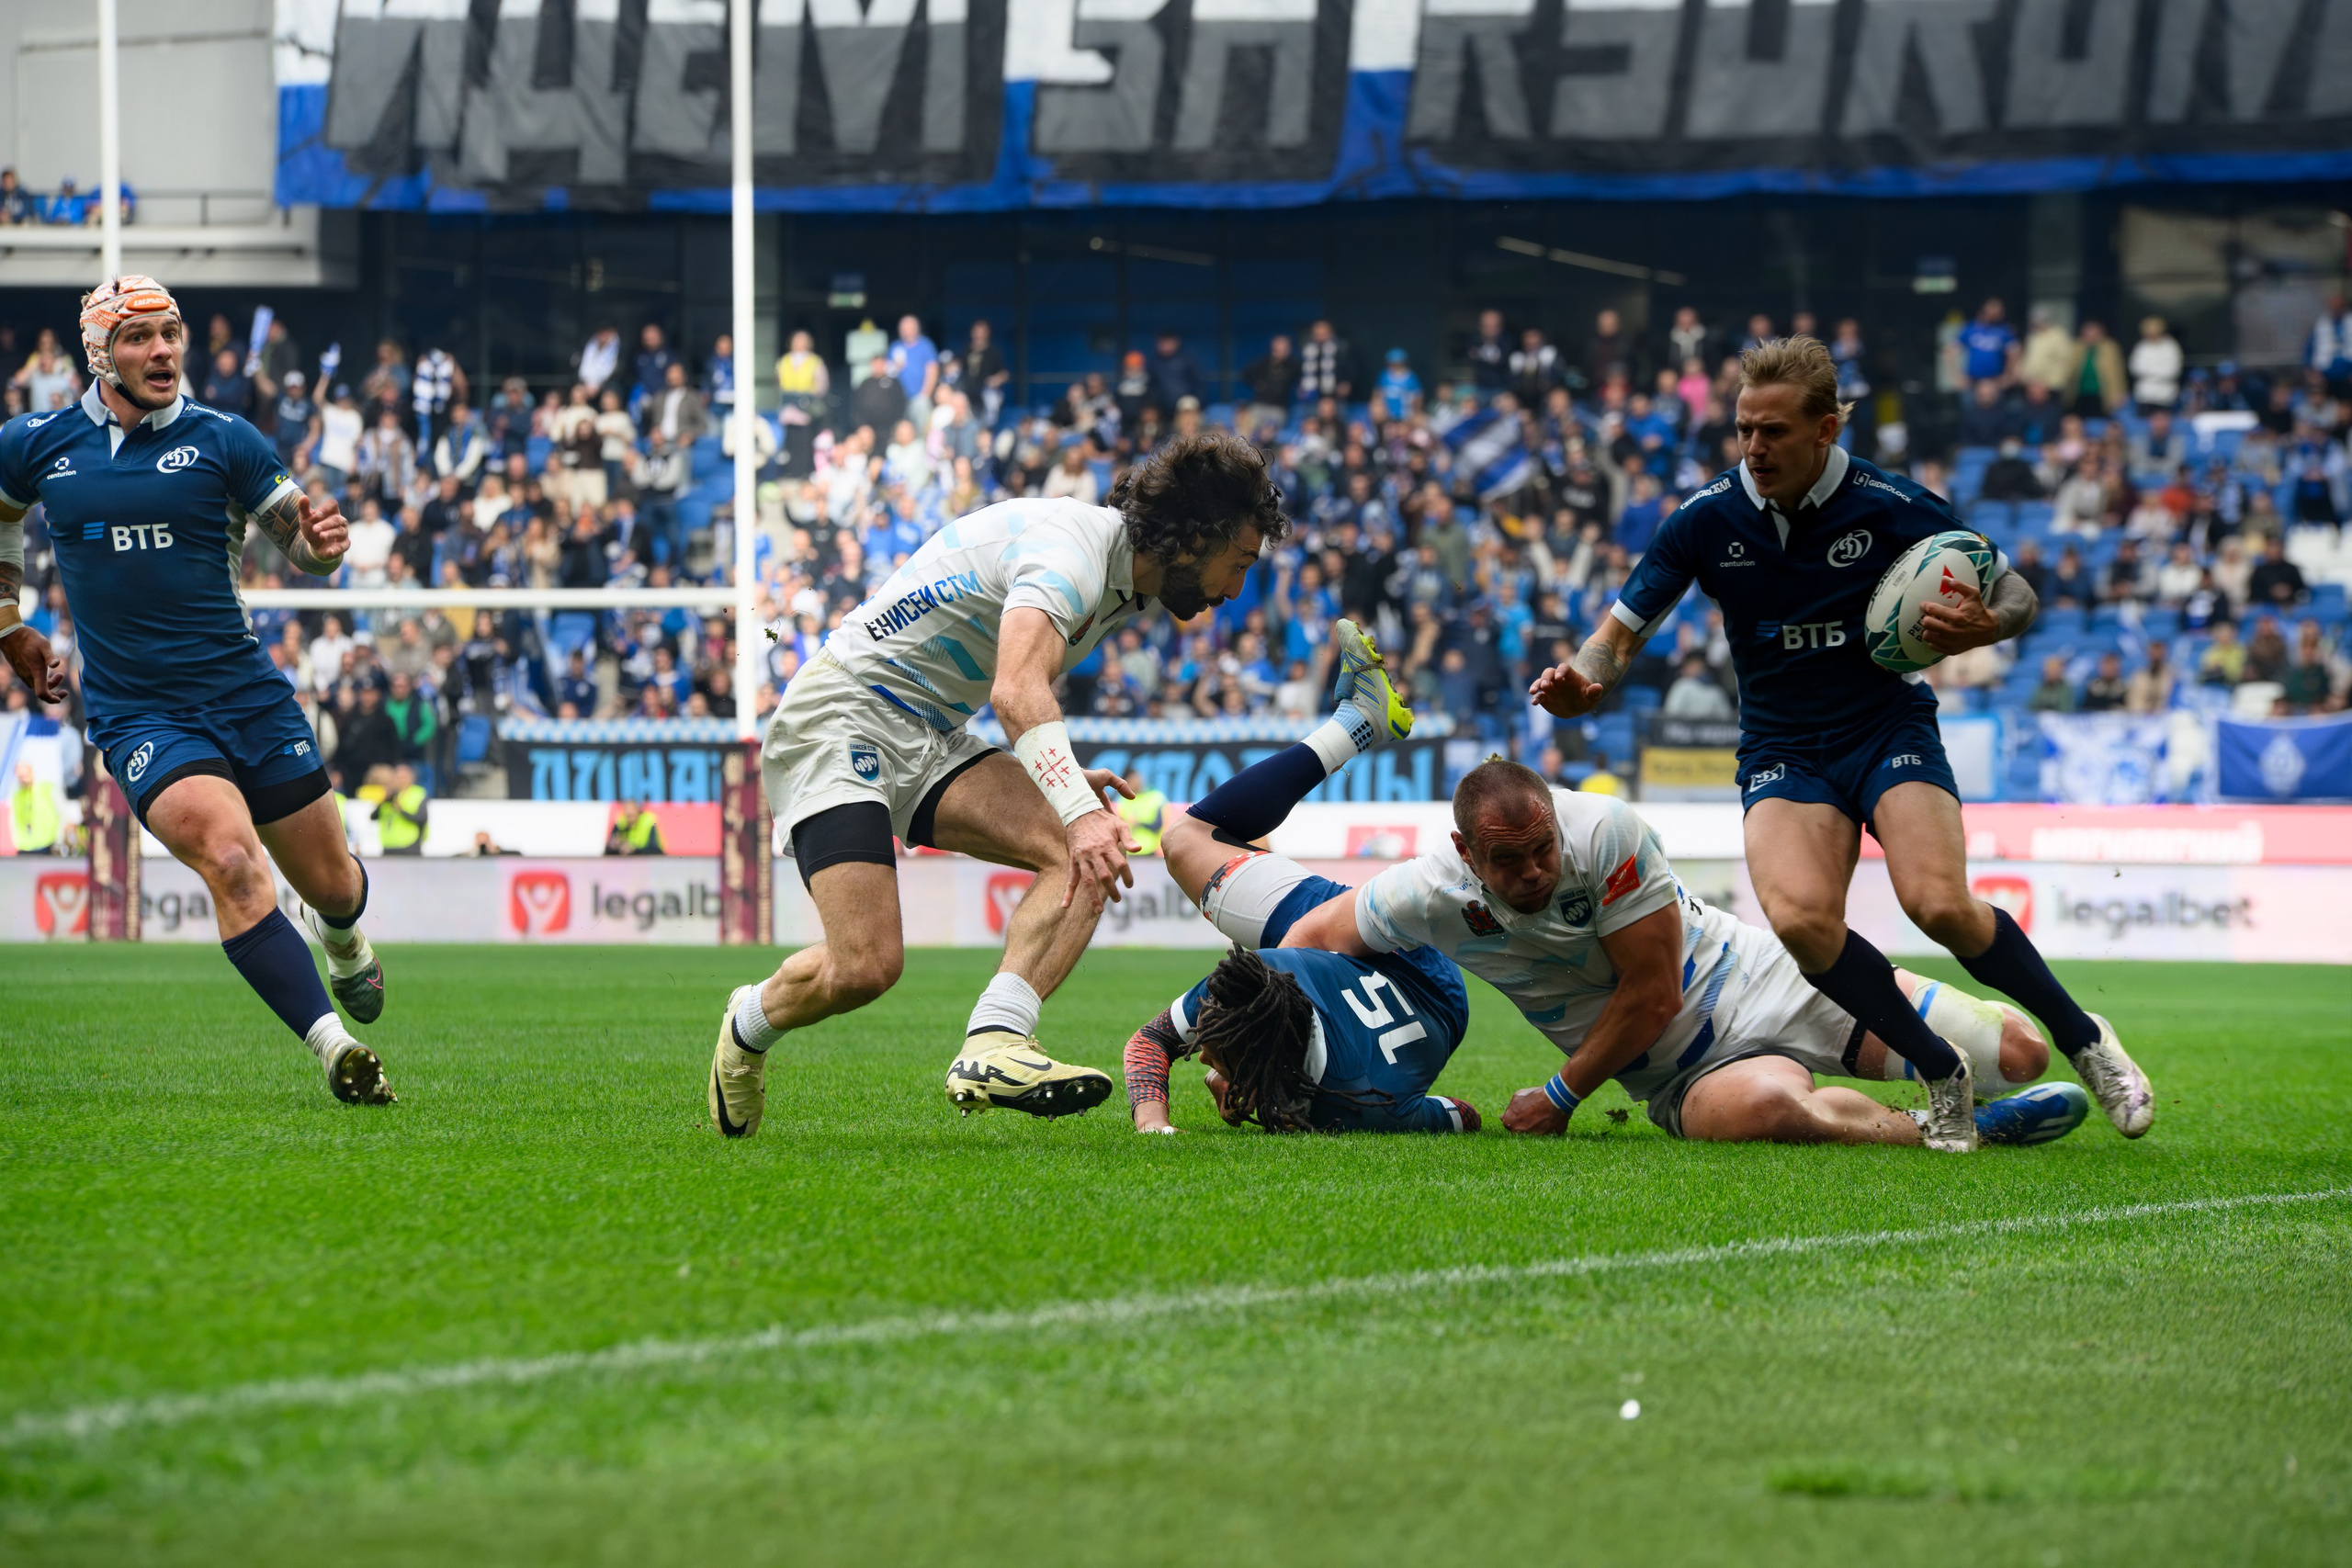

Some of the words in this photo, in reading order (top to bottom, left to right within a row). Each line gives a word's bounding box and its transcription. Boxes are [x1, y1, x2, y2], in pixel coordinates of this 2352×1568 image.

[133, 297, 167, 307] IMPACT
[192, 405, 234, 423] GIDROLOCK
[46, 469, 77, 480] centurion
[1868, 479, 1912, 503] GIDROLOCK
[111, 523, 174, 552] ВТБ
[1719, 559, 1756, 568] centurion
[934, 570, 984, 604] СТМ
[1782, 620, 1846, 649] ВТБ
[293, 739, 311, 757] ВТБ
[1892, 754, 1922, 769] ВТБ
[591, 880, 721, 931] legalb
[2054, 885, 2256, 940] legalbet
[1340, 970, 1427, 1065] 15
